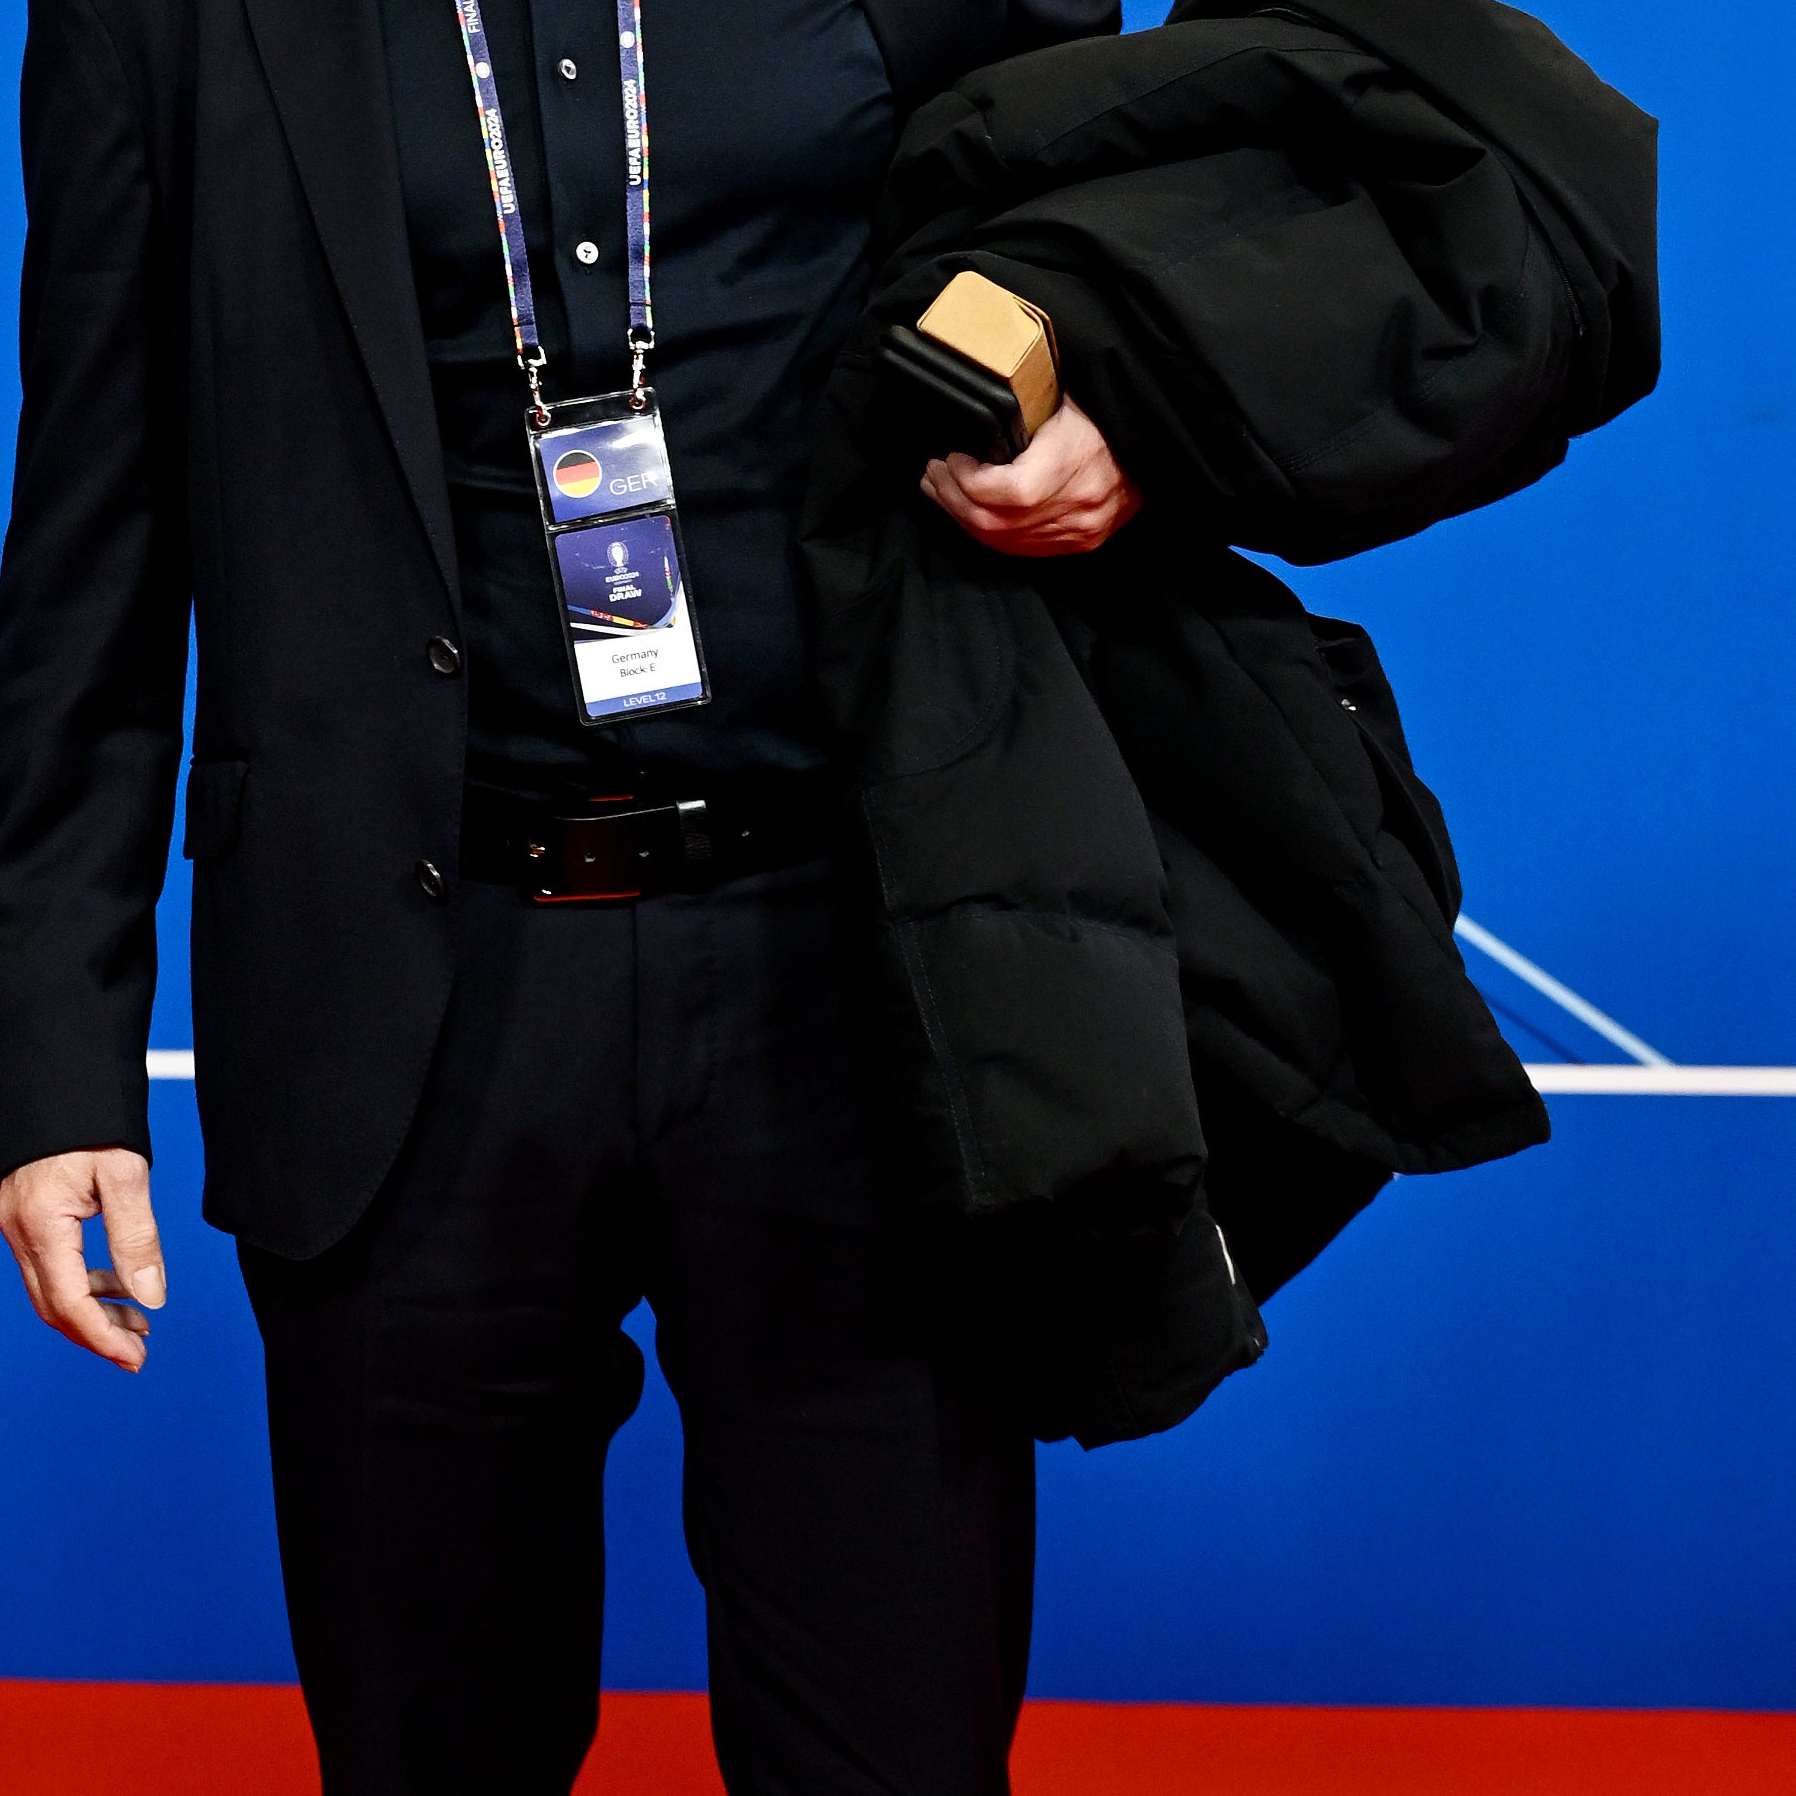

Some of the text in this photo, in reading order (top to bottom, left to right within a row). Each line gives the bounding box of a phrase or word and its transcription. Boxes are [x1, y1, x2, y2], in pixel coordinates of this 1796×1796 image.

[609, 472, 658, 497] GER
[608, 588, 642, 602] DRAW
[612, 584, 637, 594] FINAL
[611, 648, 659, 664] Germany
[619, 662, 657, 678] Block: E
[623, 691, 667, 707] LEVEL 12
